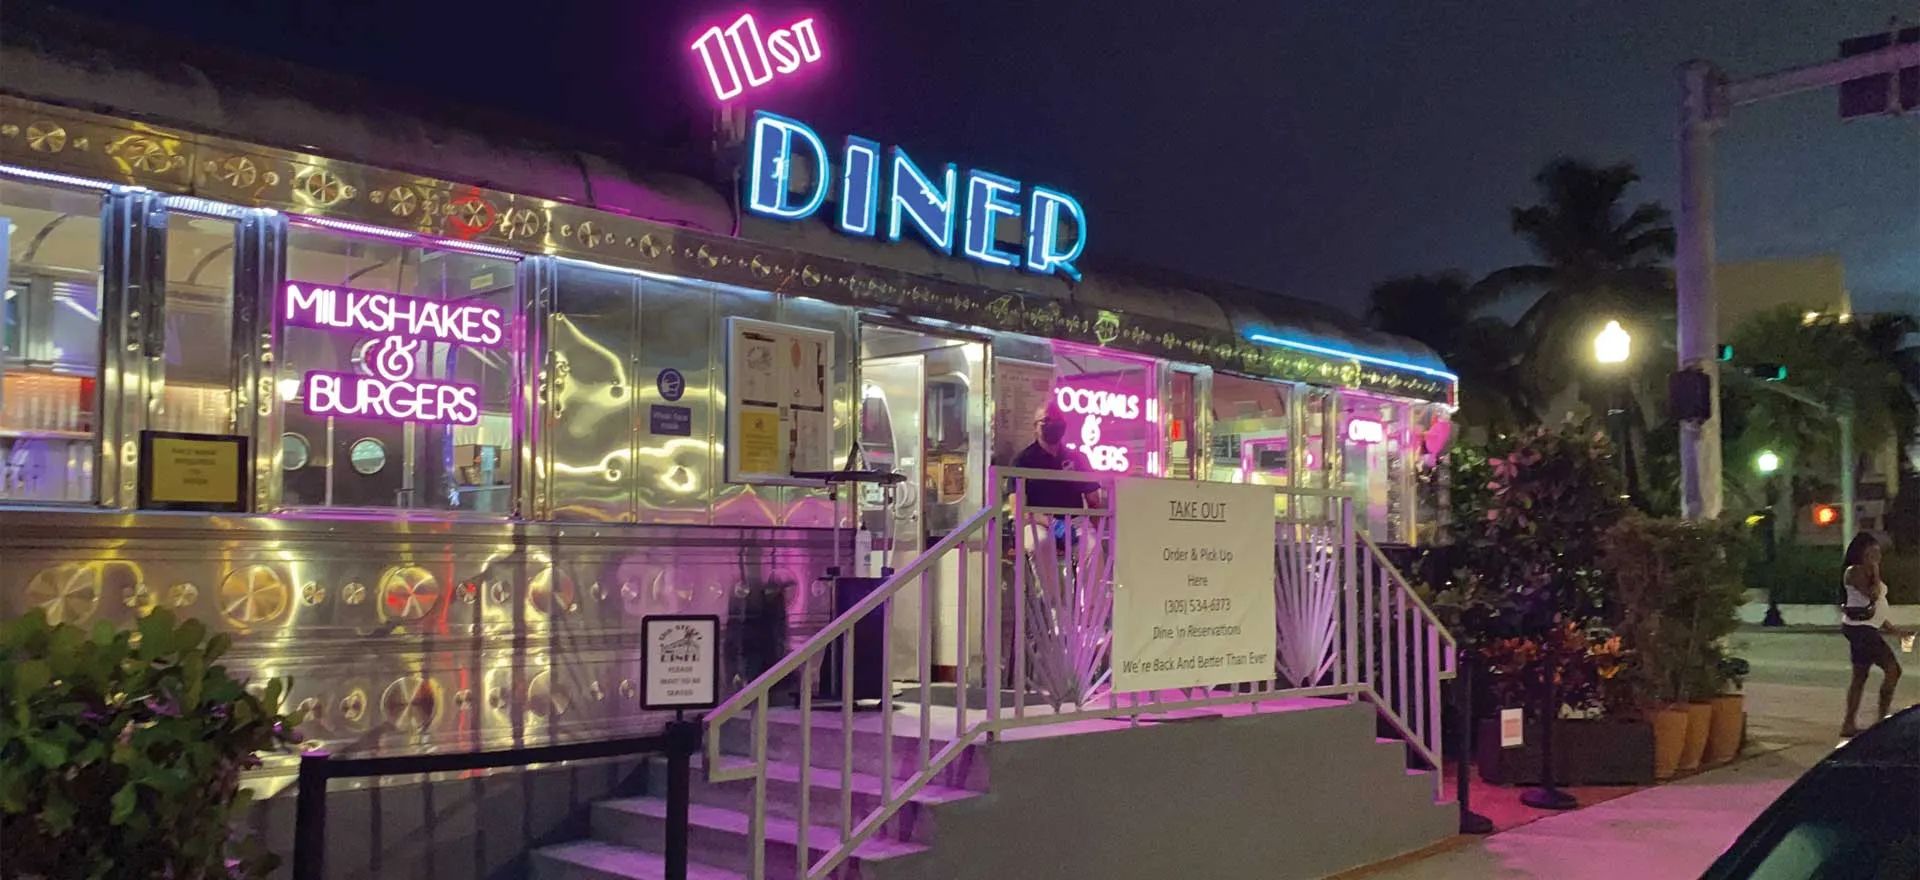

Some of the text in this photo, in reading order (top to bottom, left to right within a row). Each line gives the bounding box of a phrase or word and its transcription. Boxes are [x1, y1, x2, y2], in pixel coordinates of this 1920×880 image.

[749, 108, 1088, 283] DINER
[286, 284, 502, 344] MILKSHAKES
[376, 335, 417, 382] &
[309, 374, 478, 423] BURGERS
[1054, 386, 1140, 420] OCKTAILS
[1169, 500, 1226, 519] TAKE OUT
[1162, 547, 1233, 564] Order & Pick Up
[1187, 574, 1209, 587] Here
[1164, 599, 1187, 615] (305)
[1152, 625, 1174, 640] Dine
[1187, 623, 1242, 638] Reservations
[1122, 651, 1268, 674] We're Back And Better Than Ever
